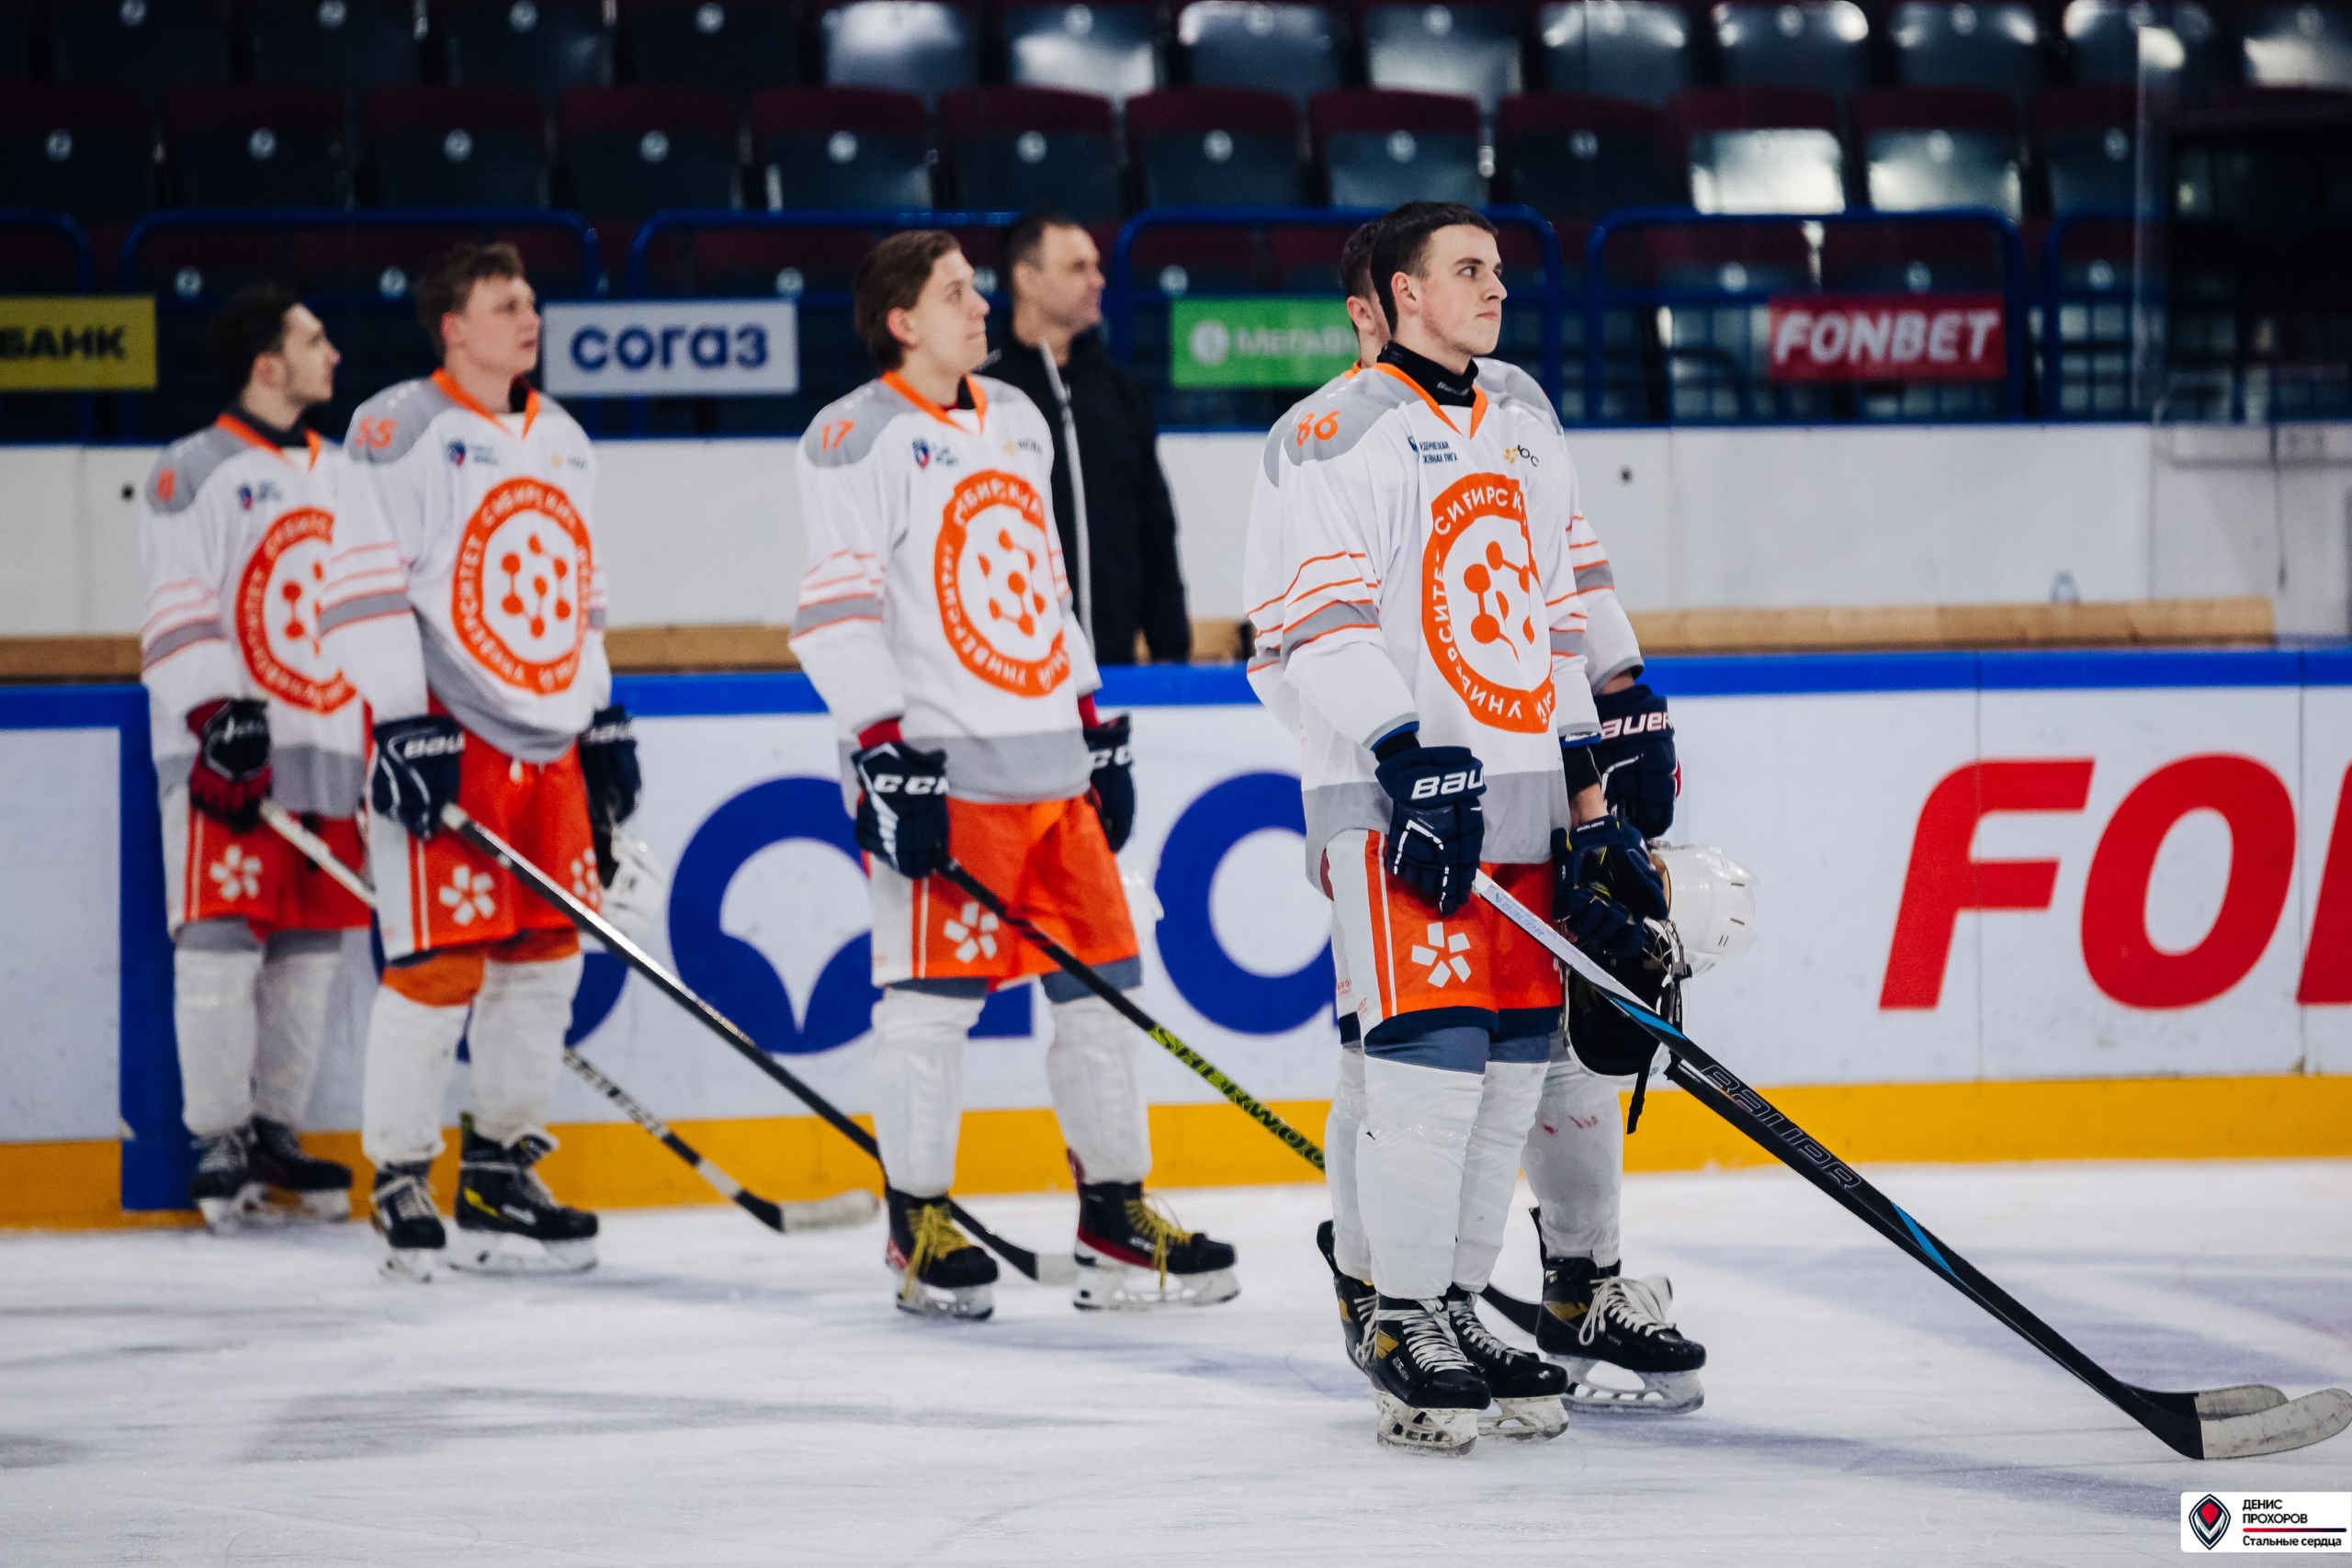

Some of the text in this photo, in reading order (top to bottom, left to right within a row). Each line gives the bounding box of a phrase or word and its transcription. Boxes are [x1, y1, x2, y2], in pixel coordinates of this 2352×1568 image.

[1774, 308, 2000, 365] FONBET
[354, 416, 398, 449] 55
[822, 420, 855, 450] 17
[1296, 411, 1341, 446] 86
[1877, 750, 2352, 1012] FO
[1700, 1064, 1862, 1190] BAUER
